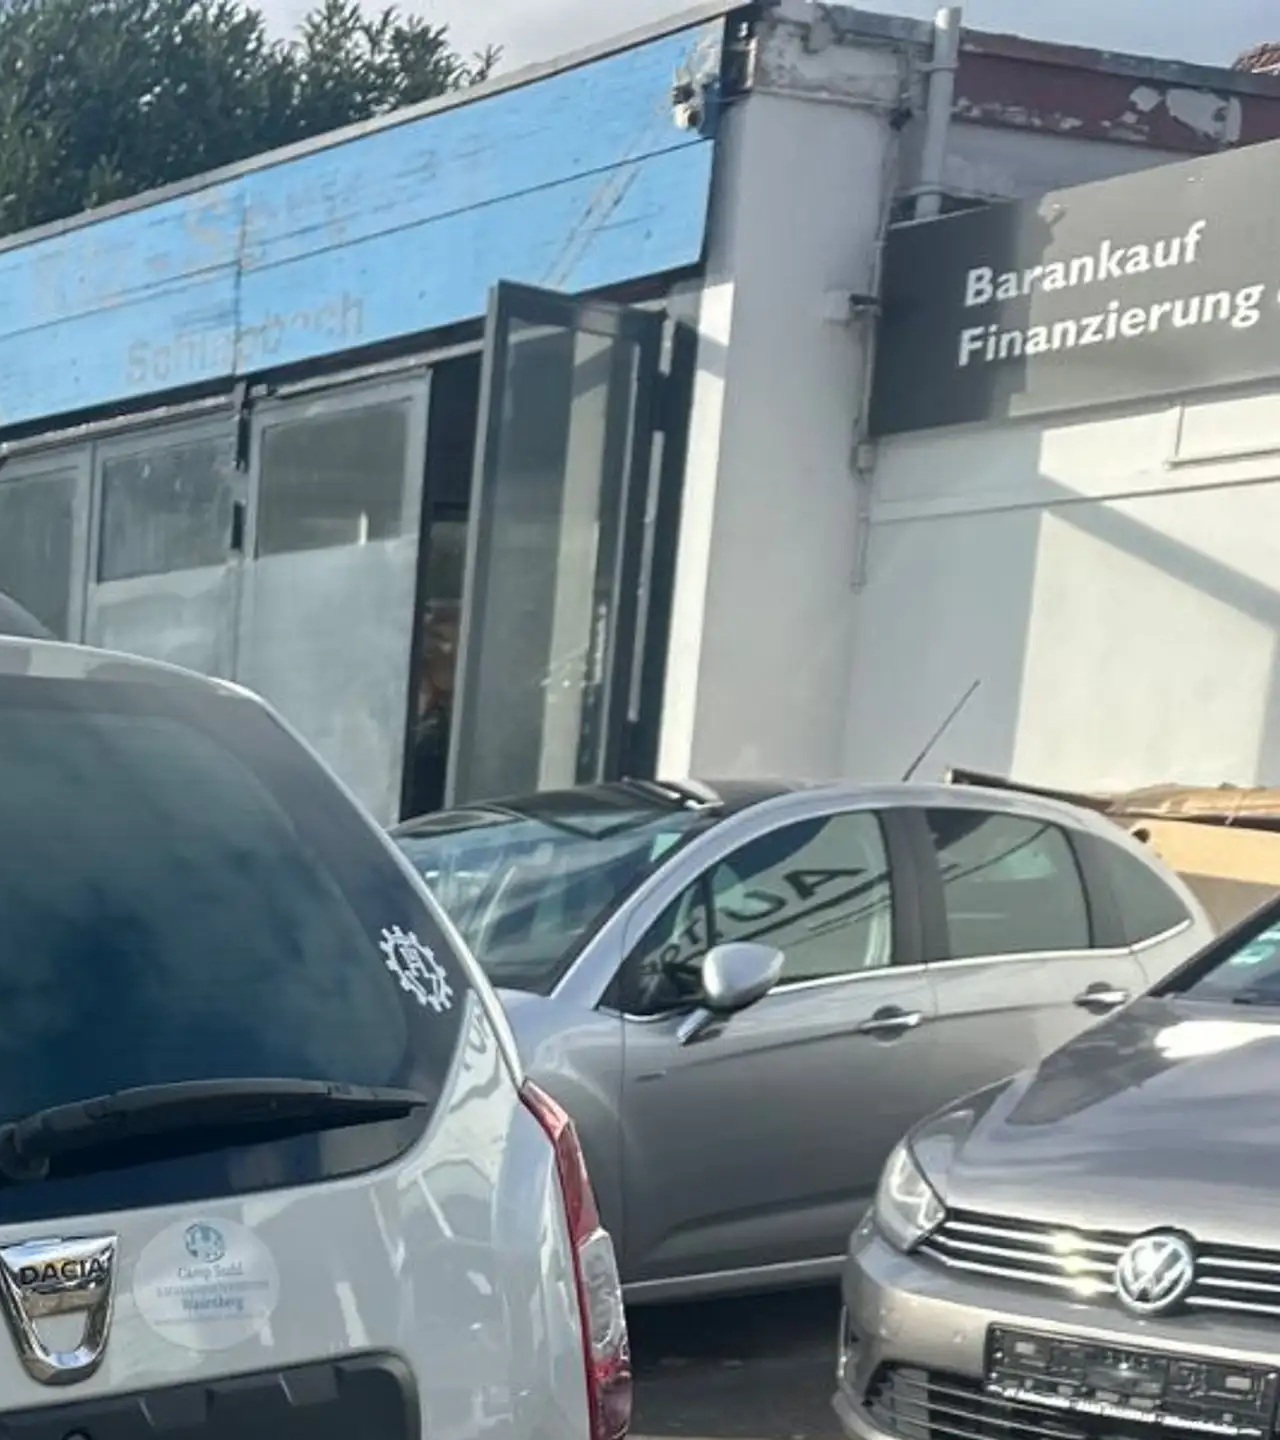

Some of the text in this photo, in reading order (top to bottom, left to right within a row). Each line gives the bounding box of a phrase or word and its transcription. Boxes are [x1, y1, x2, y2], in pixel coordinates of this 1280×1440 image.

[964, 220, 1206, 308] Barankauf
[958, 284, 1265, 367] Finanzierung
[20, 1257, 106, 1286] DACIA
